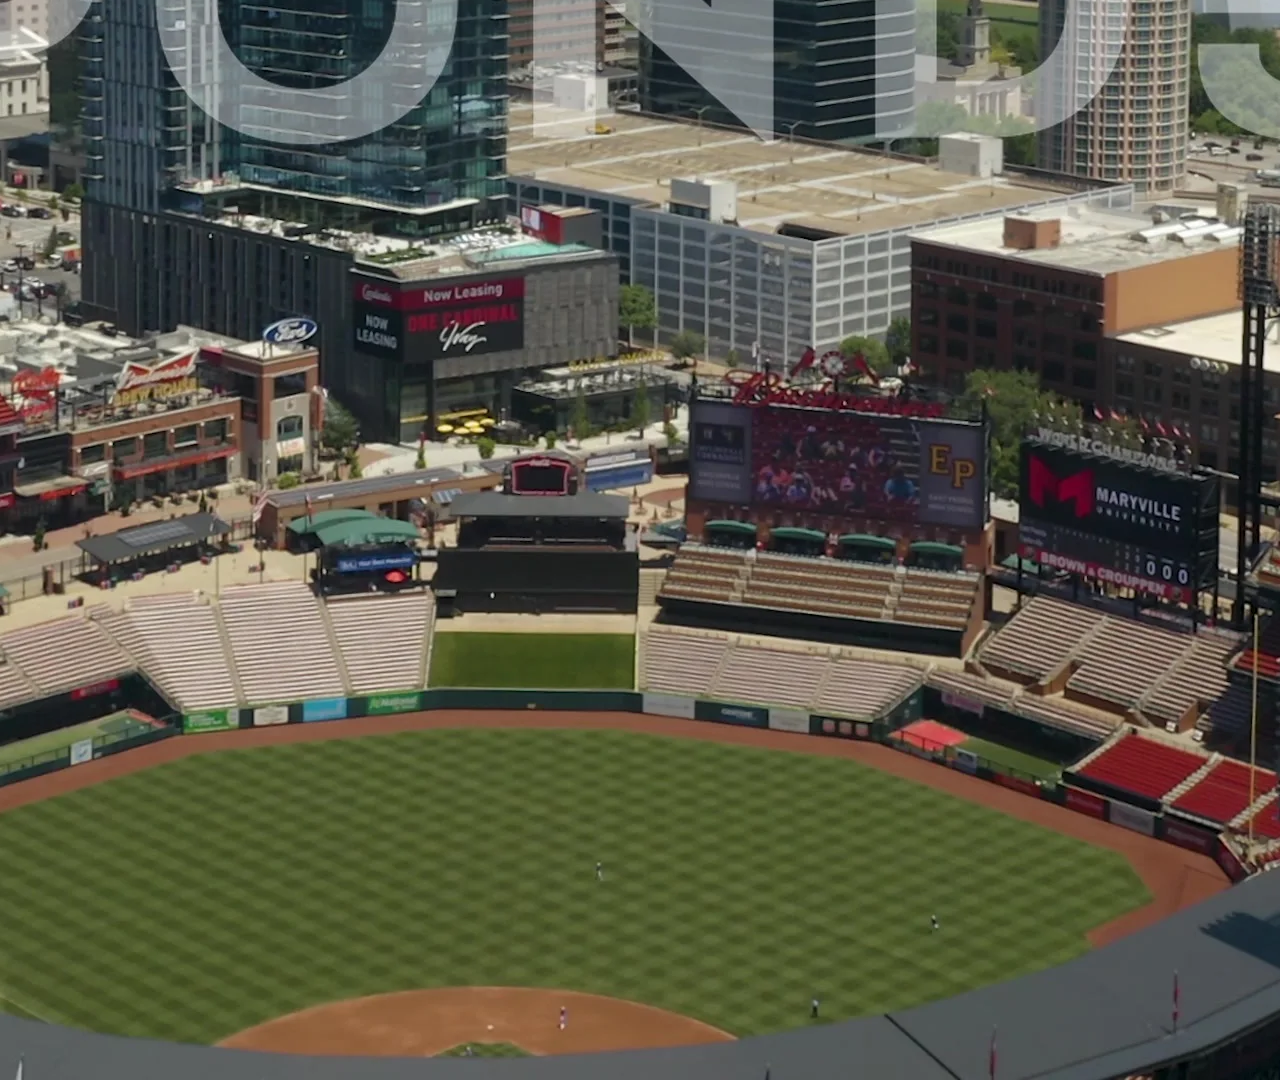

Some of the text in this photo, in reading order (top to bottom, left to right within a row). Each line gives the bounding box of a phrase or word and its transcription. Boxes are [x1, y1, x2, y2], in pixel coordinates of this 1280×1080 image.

[424, 283, 503, 303] Now Leasing
[365, 314, 388, 330] NOW
[408, 304, 518, 332] ONE CARDINAL
[274, 322, 307, 342] Ford
[356, 329, 397, 349] LEASING
[439, 320, 487, 352] Way
[1096, 486, 1181, 521] MARYVILLE
[1096, 506, 1180, 533] UNIVERSITY
[1040, 551, 1086, 574] BROWN
[1096, 567, 1167, 596] CROUPPEN
[1146, 560, 1156, 576] 0
[1162, 565, 1172, 580] 0
[1178, 569, 1188, 585] 0
